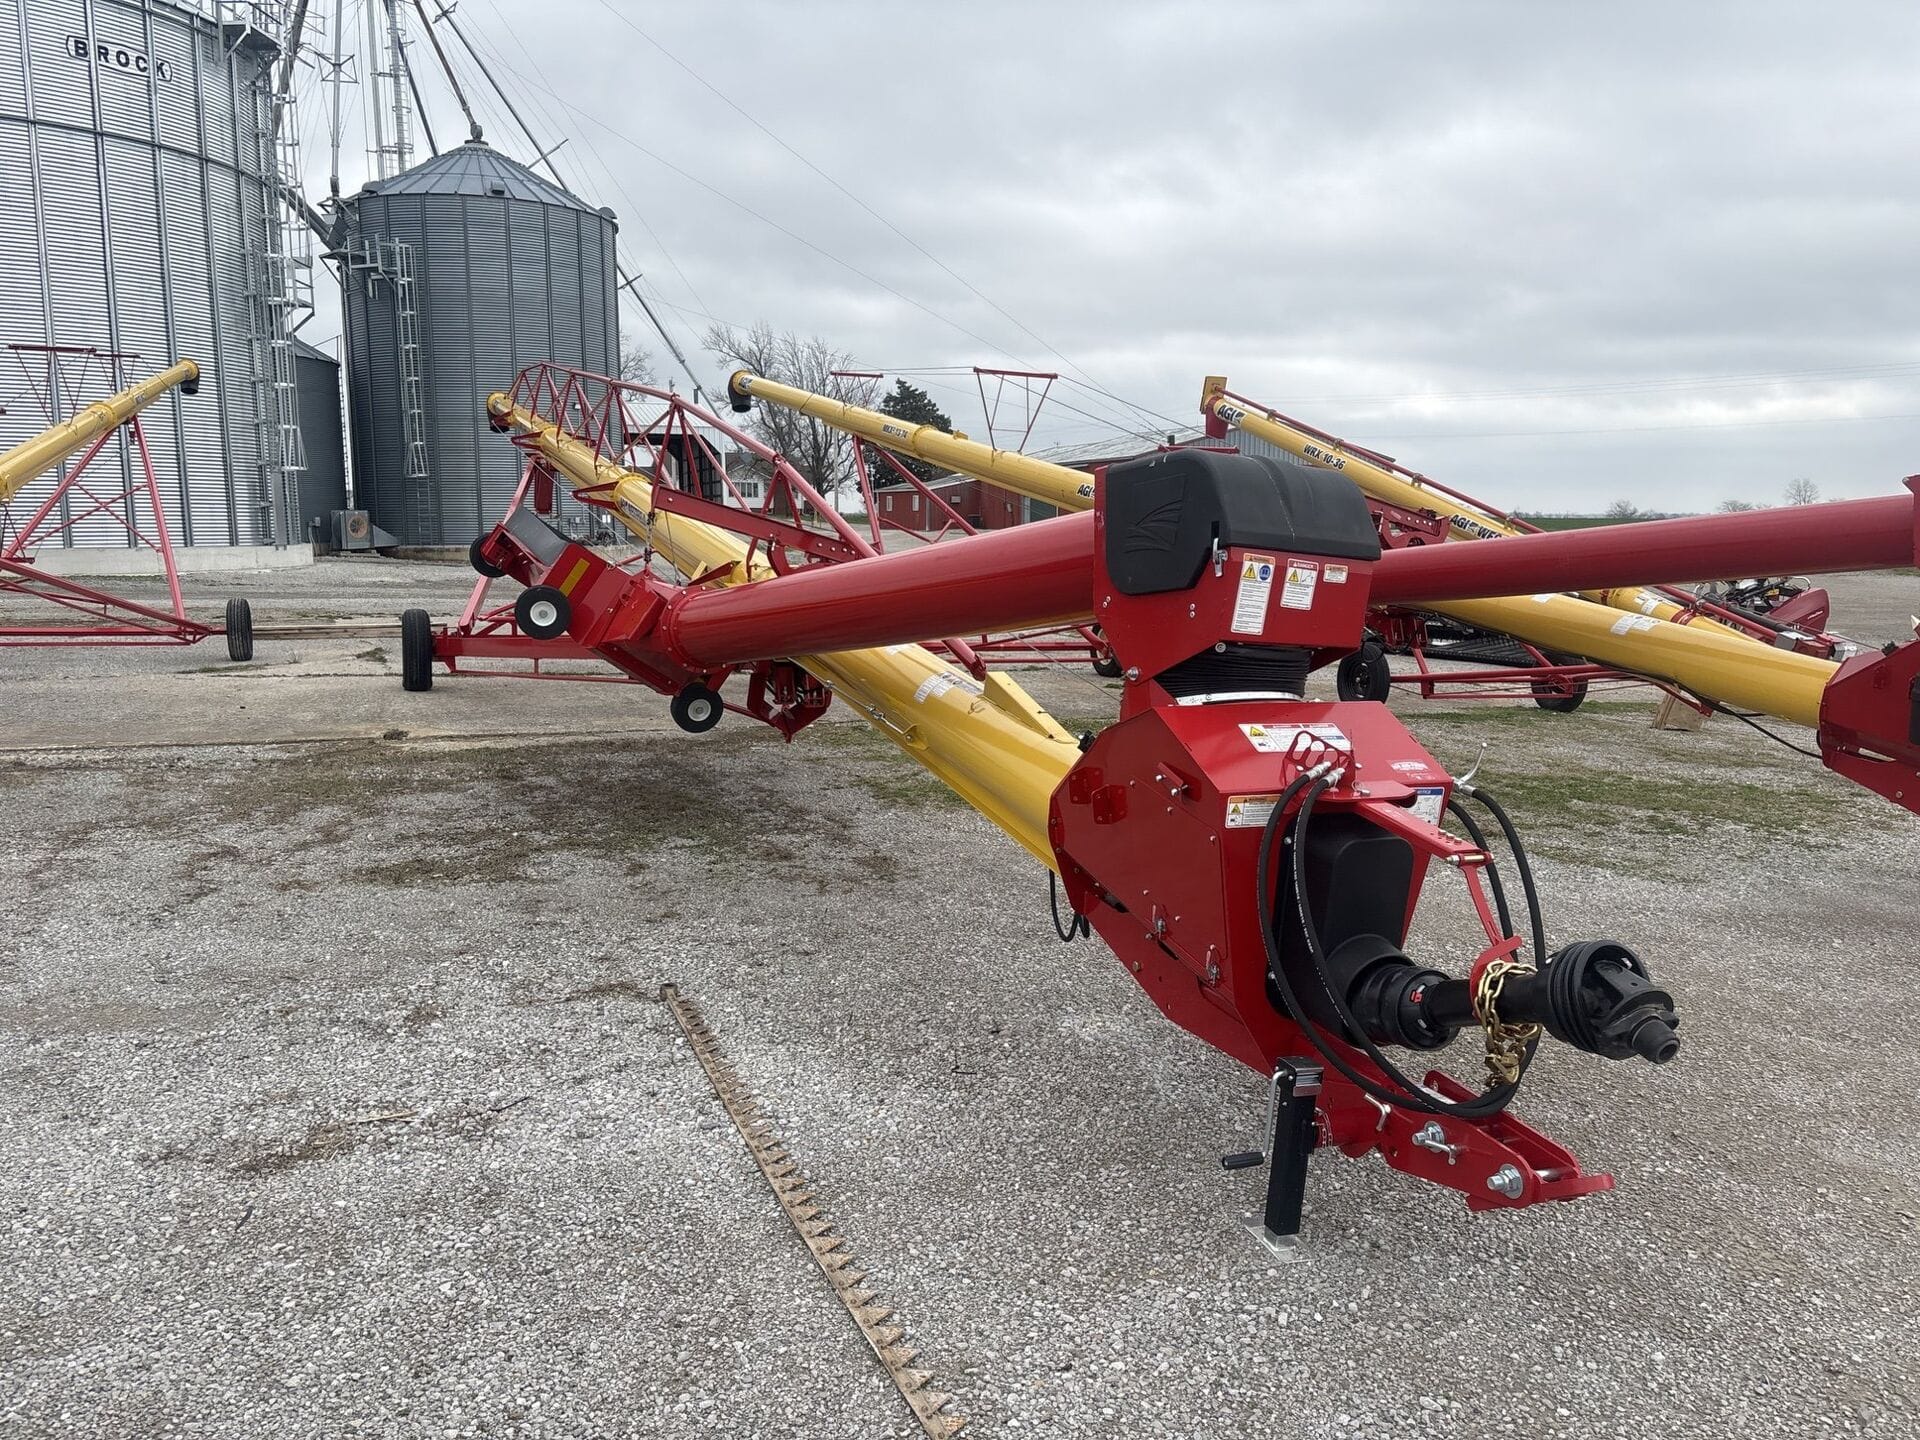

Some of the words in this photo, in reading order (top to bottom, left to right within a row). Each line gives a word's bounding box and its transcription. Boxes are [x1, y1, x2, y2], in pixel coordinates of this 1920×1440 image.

[74, 39, 166, 79] BROCK
[1217, 404, 1237, 421] AGI
[1303, 443, 1321, 459] WRX
[1322, 453, 1346, 470] 10-36
[1077, 484, 1092, 497] AGI
[1450, 514, 1470, 530] AGI
